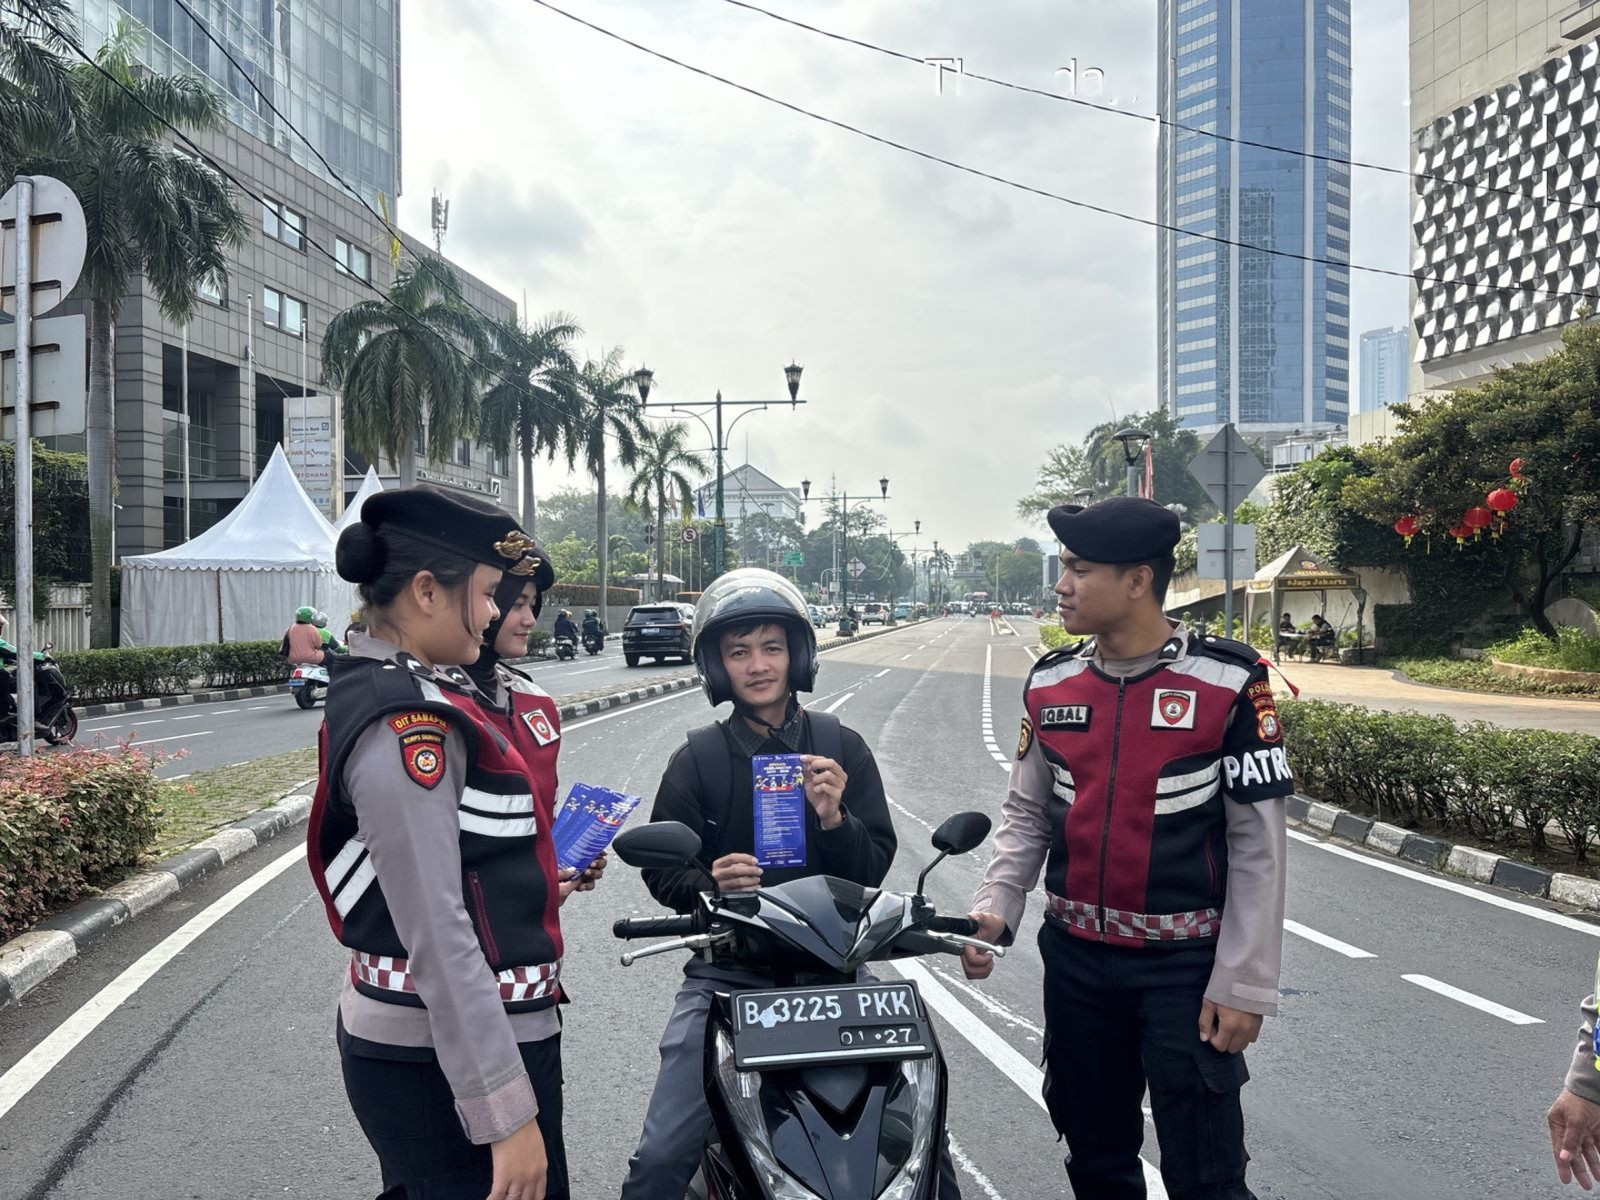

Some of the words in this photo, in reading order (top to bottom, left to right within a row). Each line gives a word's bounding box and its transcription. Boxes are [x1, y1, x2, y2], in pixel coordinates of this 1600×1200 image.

[1313, 578, 1347, 586] Jakarta
[1041, 706, 1083, 723] IQBAL
[394, 716, 410, 729] DIT
[744, 1001, 760, 1025] B
[772, 994, 842, 1024] 3225
[858, 990, 912, 1017] PKK
